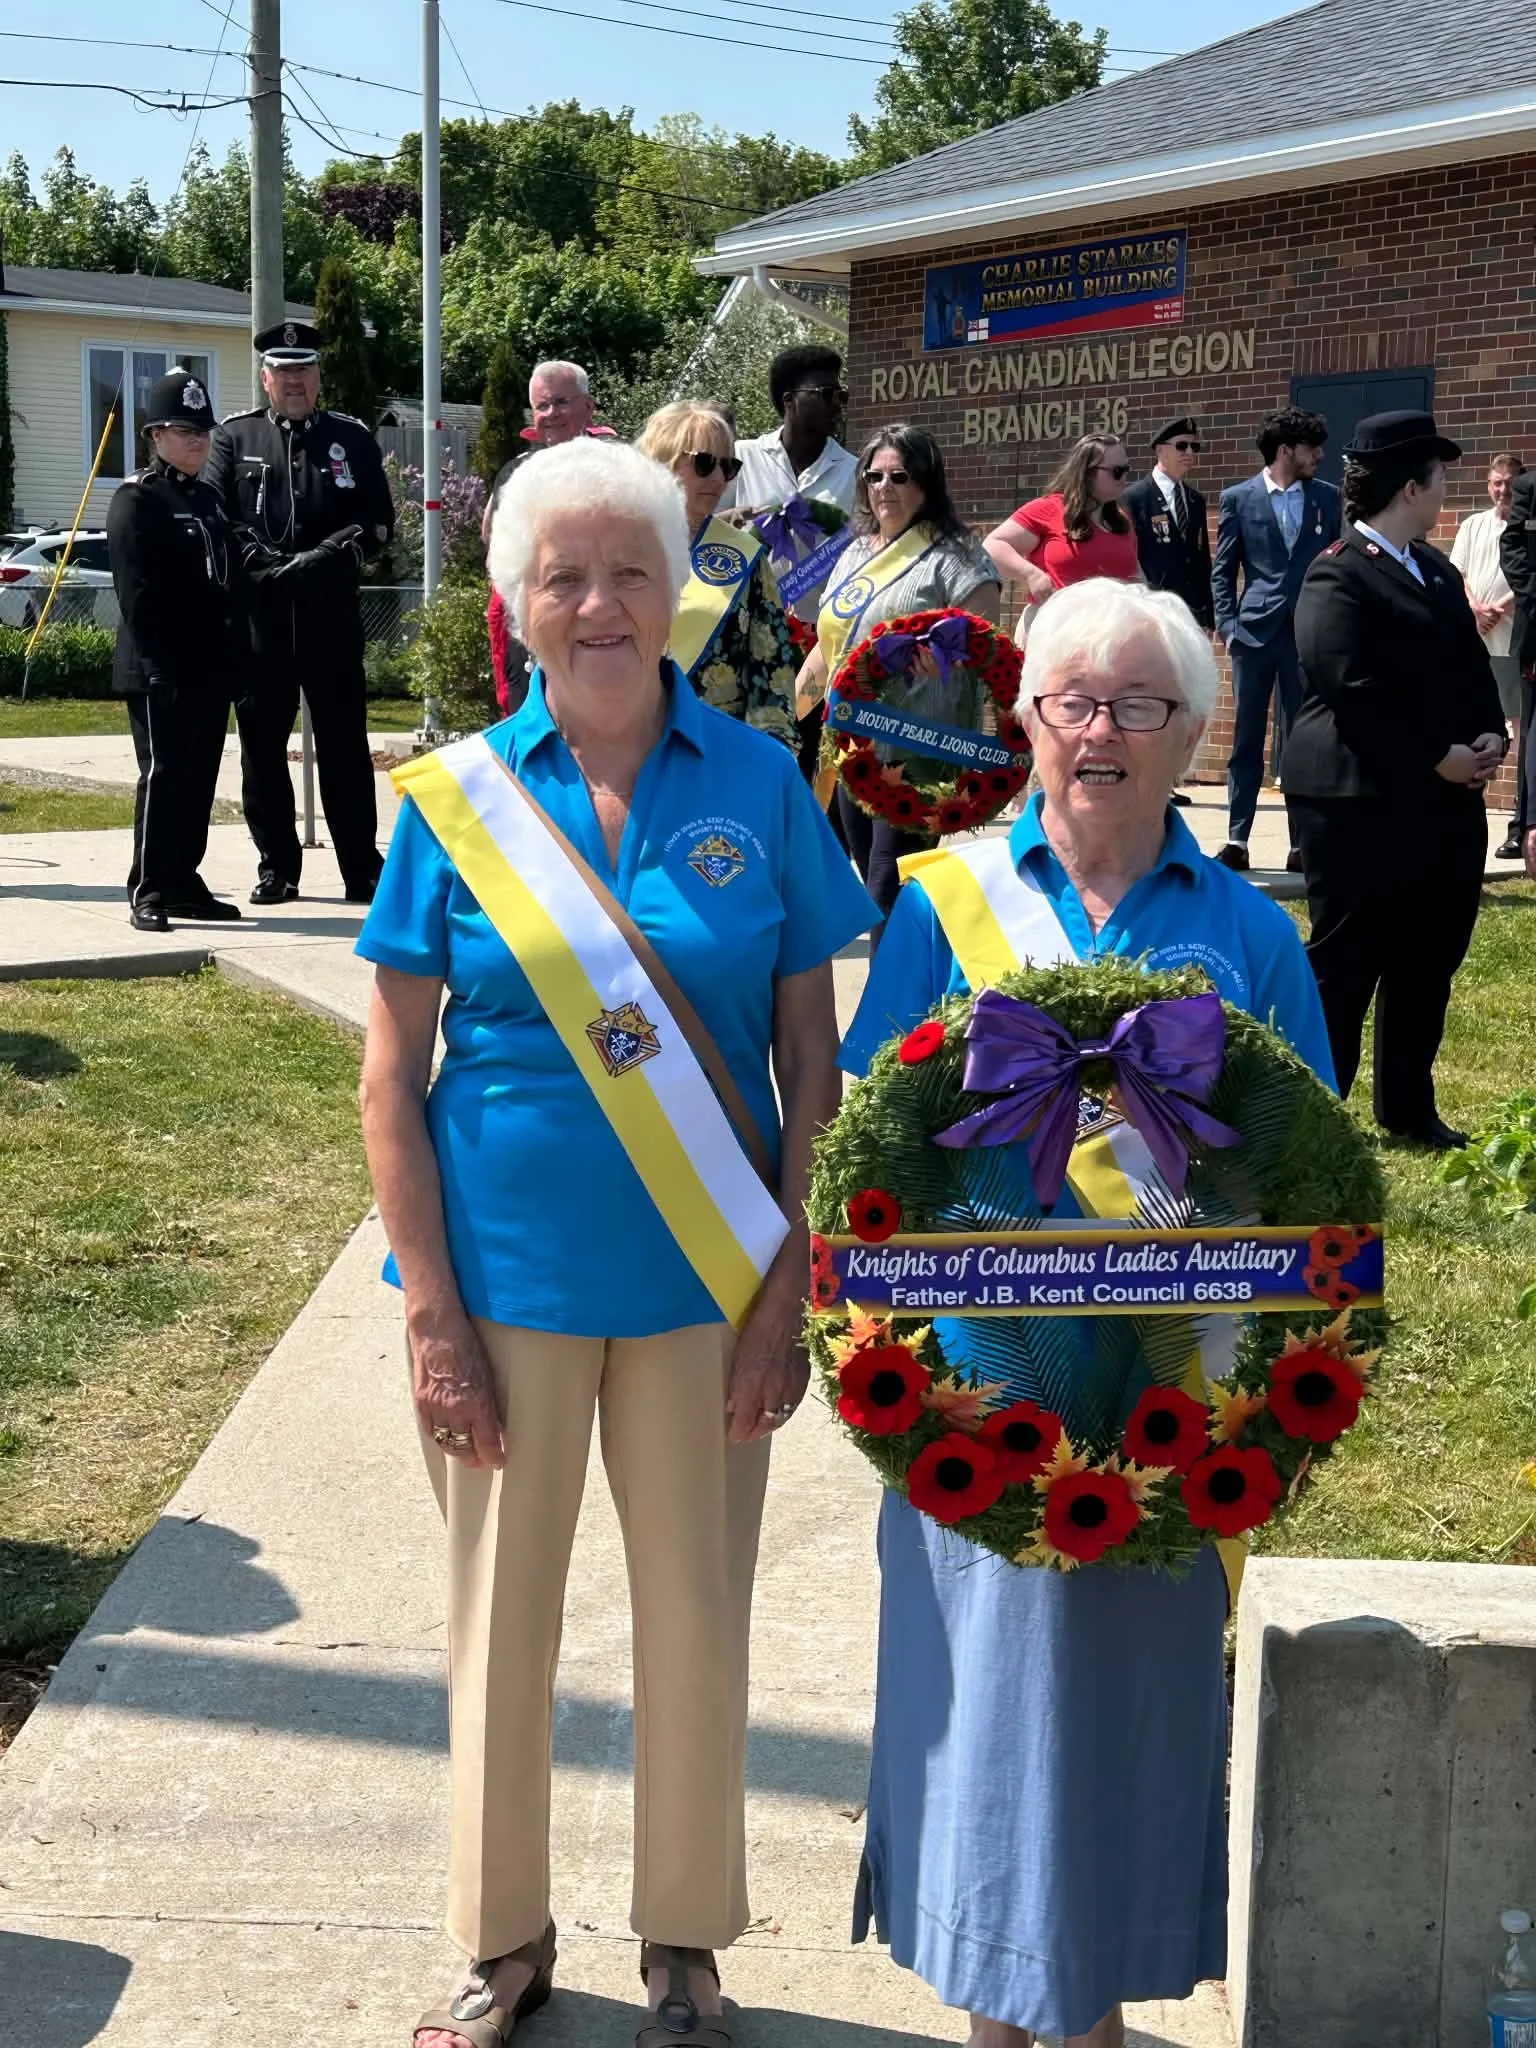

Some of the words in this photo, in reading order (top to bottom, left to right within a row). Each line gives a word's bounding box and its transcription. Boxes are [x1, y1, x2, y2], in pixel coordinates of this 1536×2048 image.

[981, 254, 1073, 288] CHARLIE
[1078, 238, 1179, 275] STARKES
[981, 281, 1076, 313] MEMORIAL
[1082, 266, 1177, 298] BUILDING
[871, 361, 958, 402] ROYAL
[965, 343, 1118, 394] CANADIAN
[1128, 328, 1256, 380] LEGION
[963, 400, 1085, 445] BRANCH
[1095, 396, 1129, 435] 36
[1366, 543, 1380, 555] S
[855, 709, 900, 734] MOUNT
[899, 722, 938, 746] PEARL
[939, 735, 978, 757] LIONS
[978, 746, 1010, 765] CLUB
[847, 1248, 937, 1284] Knights
[945, 1248, 975, 1280] of
[978, 1246, 1097, 1276] Columbus
[1104, 1243, 1179, 1273] Ladies
[1184, 1241, 1297, 1277] Auxiliary
[891, 1287, 967, 1306] Father
[975, 1286, 1021, 1305] J.B.
[1029, 1285, 1085, 1304] Kent
[1092, 1282, 1185, 1303] Council
[1193, 1281, 1253, 1301] 6638
